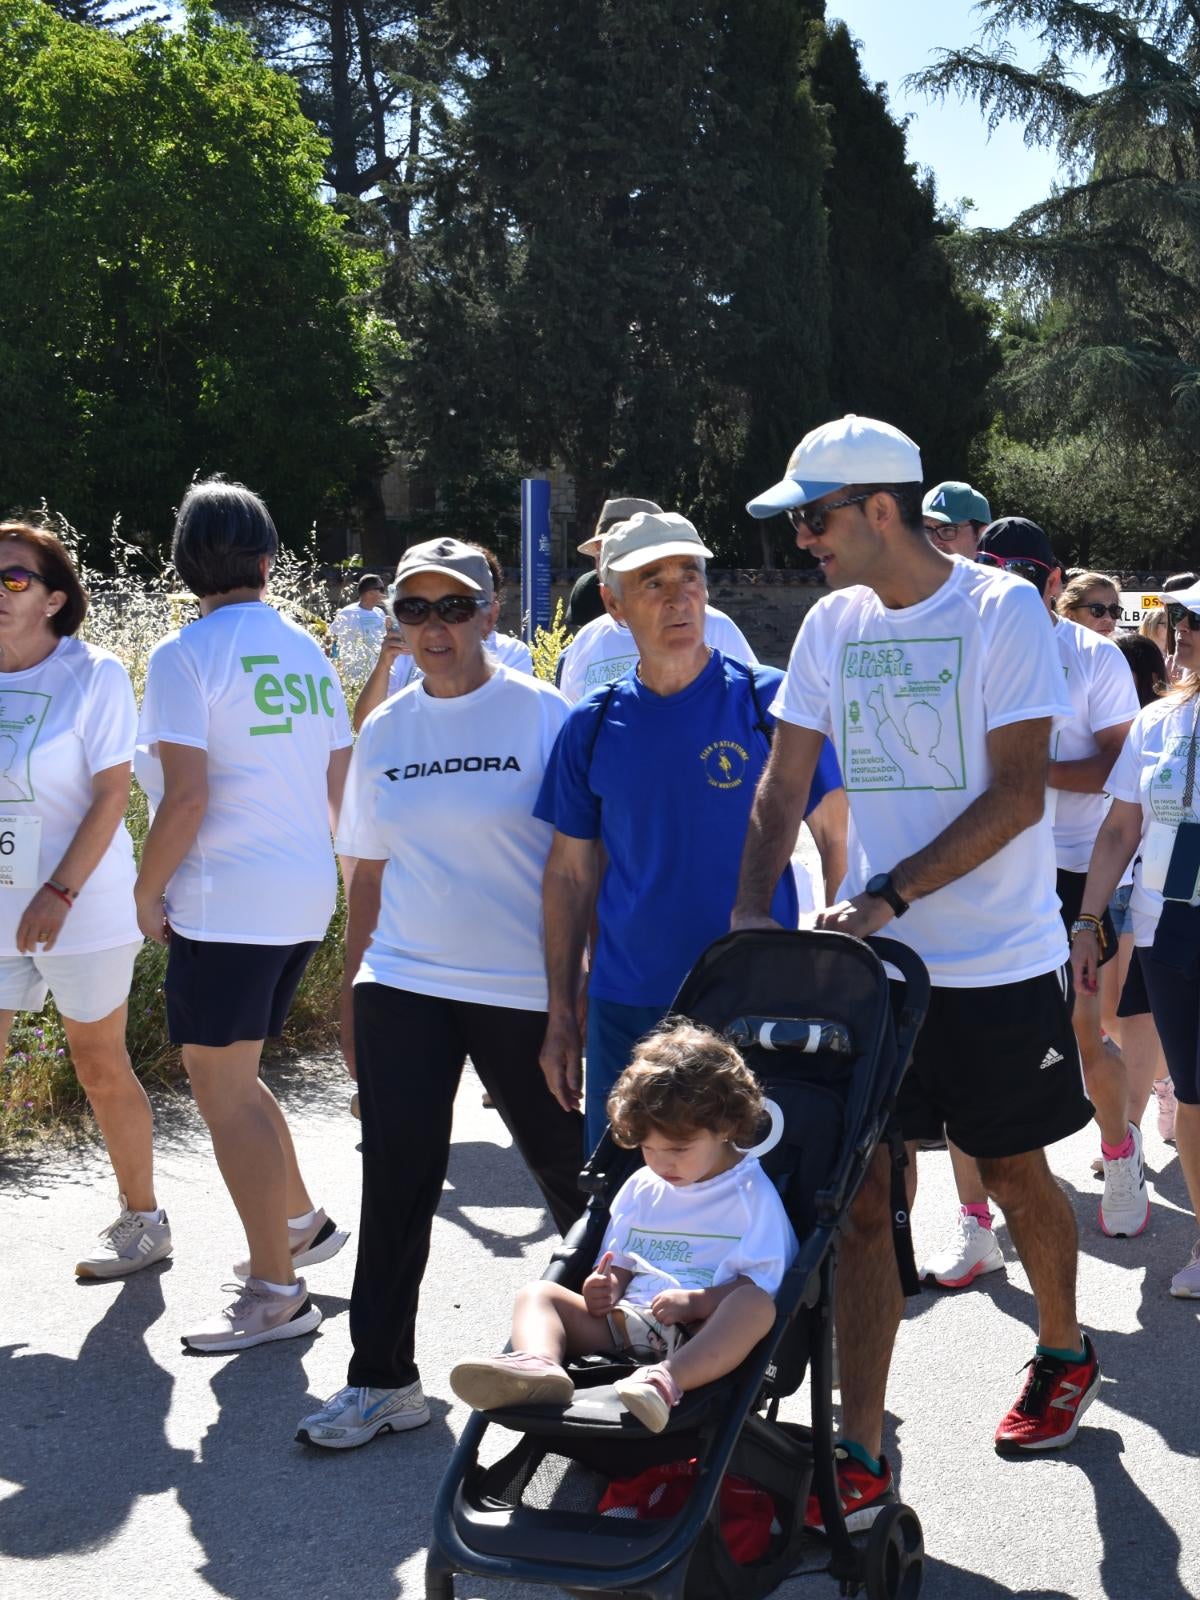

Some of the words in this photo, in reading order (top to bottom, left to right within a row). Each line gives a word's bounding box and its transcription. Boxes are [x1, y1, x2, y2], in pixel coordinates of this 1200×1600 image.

[404, 756, 521, 779] DIADORA
[1040, 1054, 1064, 1069] adidas
[650, 1240, 690, 1251] PASEO
